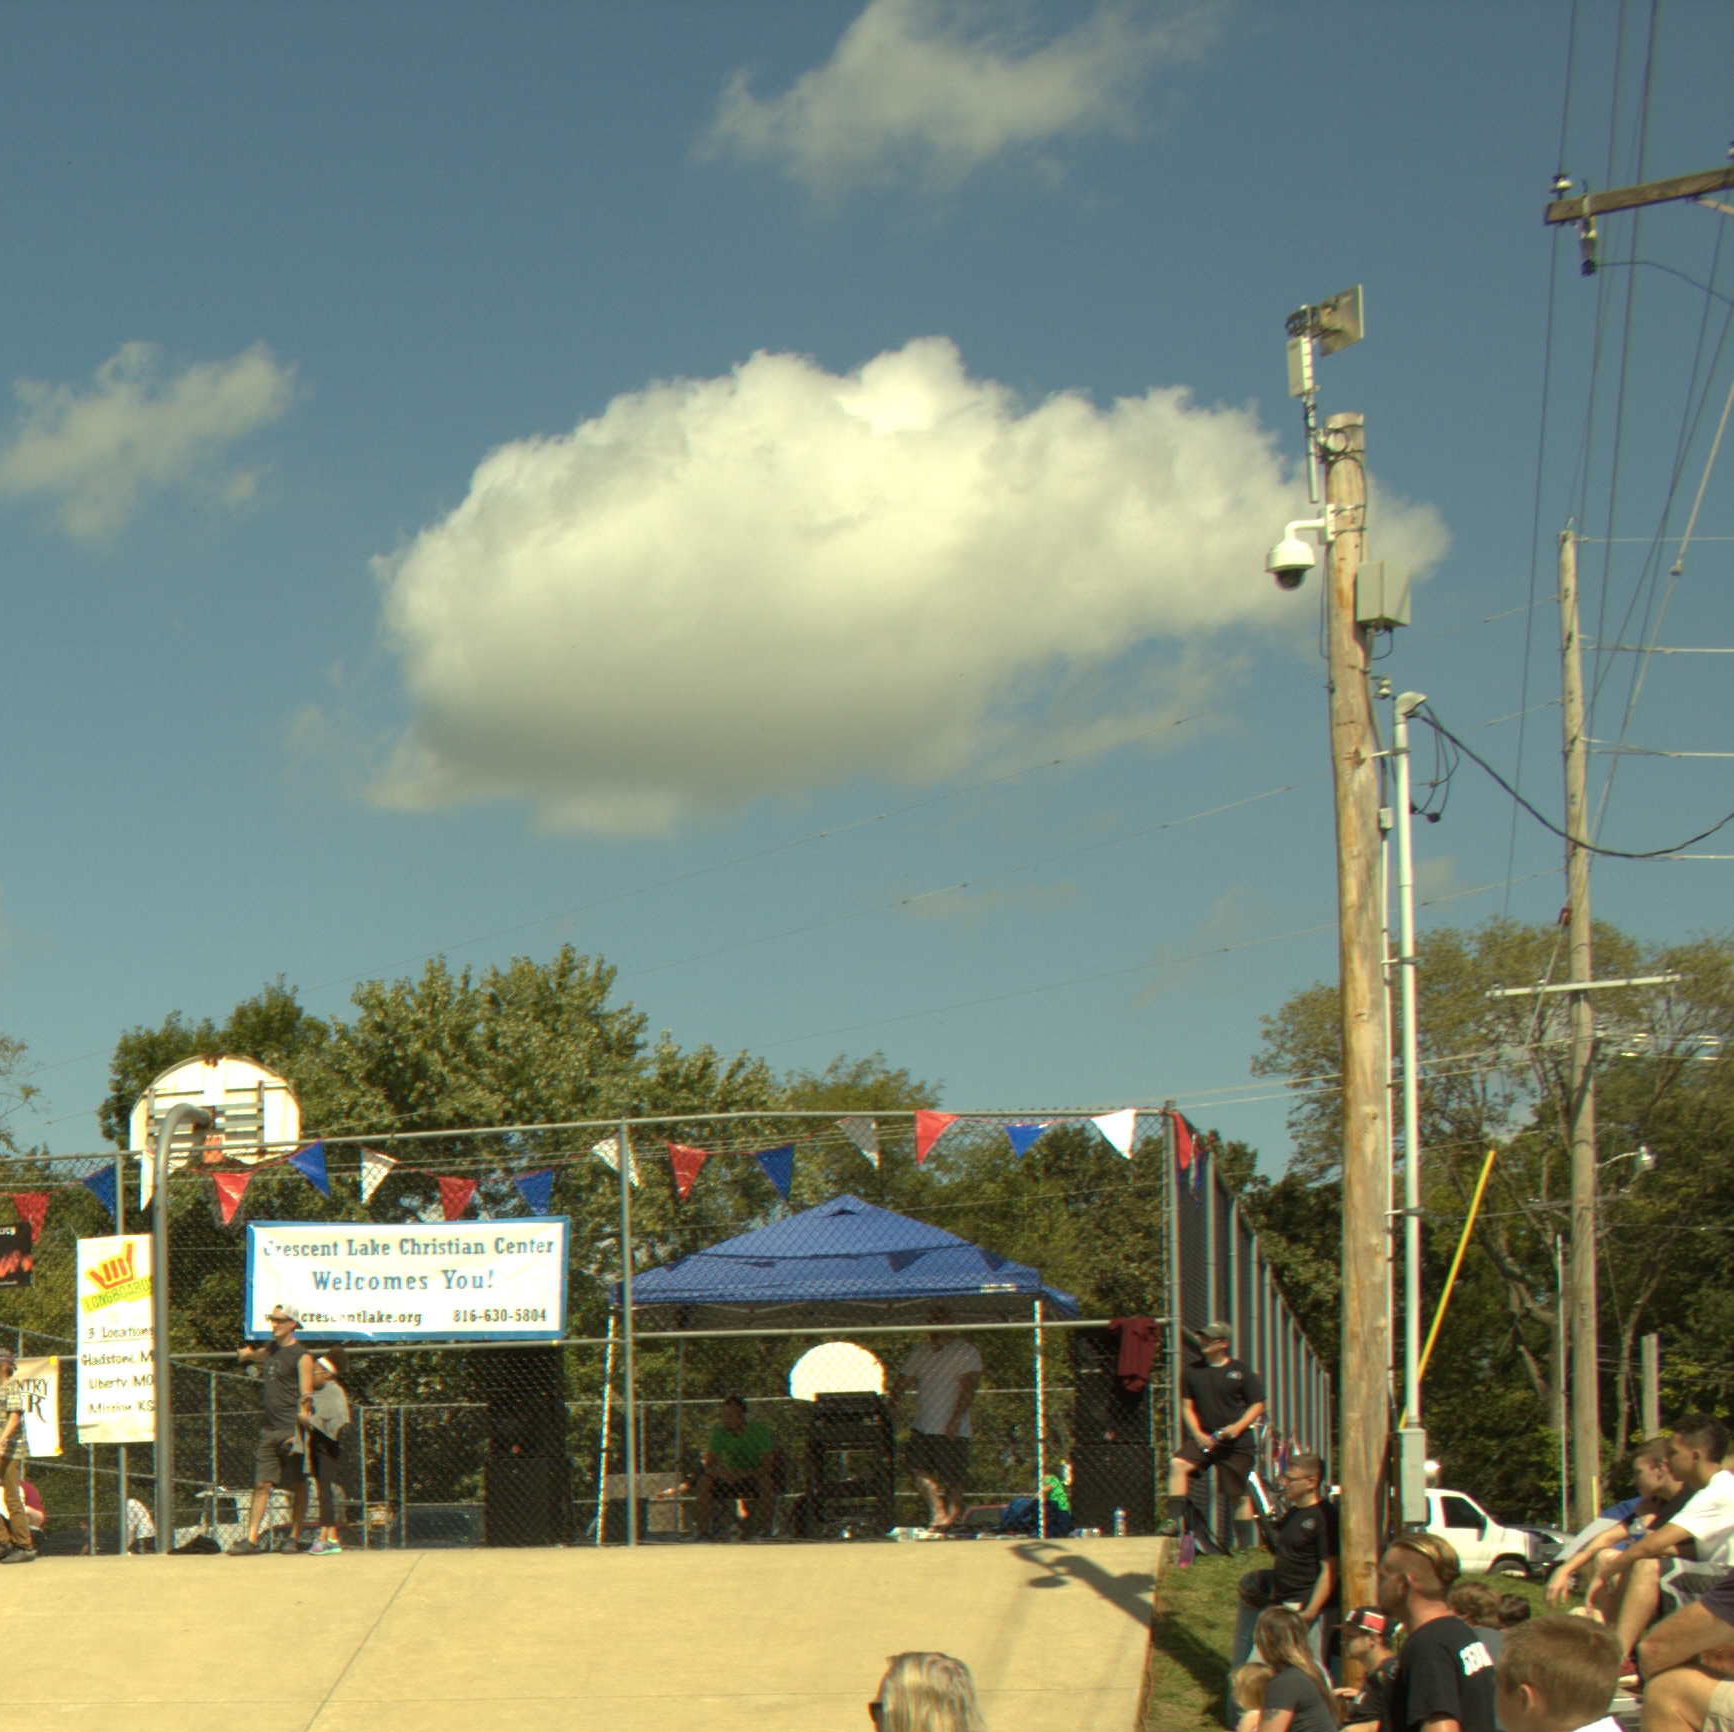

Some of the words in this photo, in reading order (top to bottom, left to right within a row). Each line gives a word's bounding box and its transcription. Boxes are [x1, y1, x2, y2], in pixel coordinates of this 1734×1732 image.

[263, 1238, 339, 1257] Crescent
[347, 1238, 391, 1256] Lake
[399, 1237, 486, 1256] Christian
[494, 1236, 554, 1255] Center
[312, 1270, 429, 1291] Welcomes
[442, 1269, 495, 1290] You!
[453, 1308, 548, 1323] 816-630-5804
[88, 1326, 96, 1340] 3
[140, 1350, 154, 1364] M
[138, 1398, 155, 1413] KS
